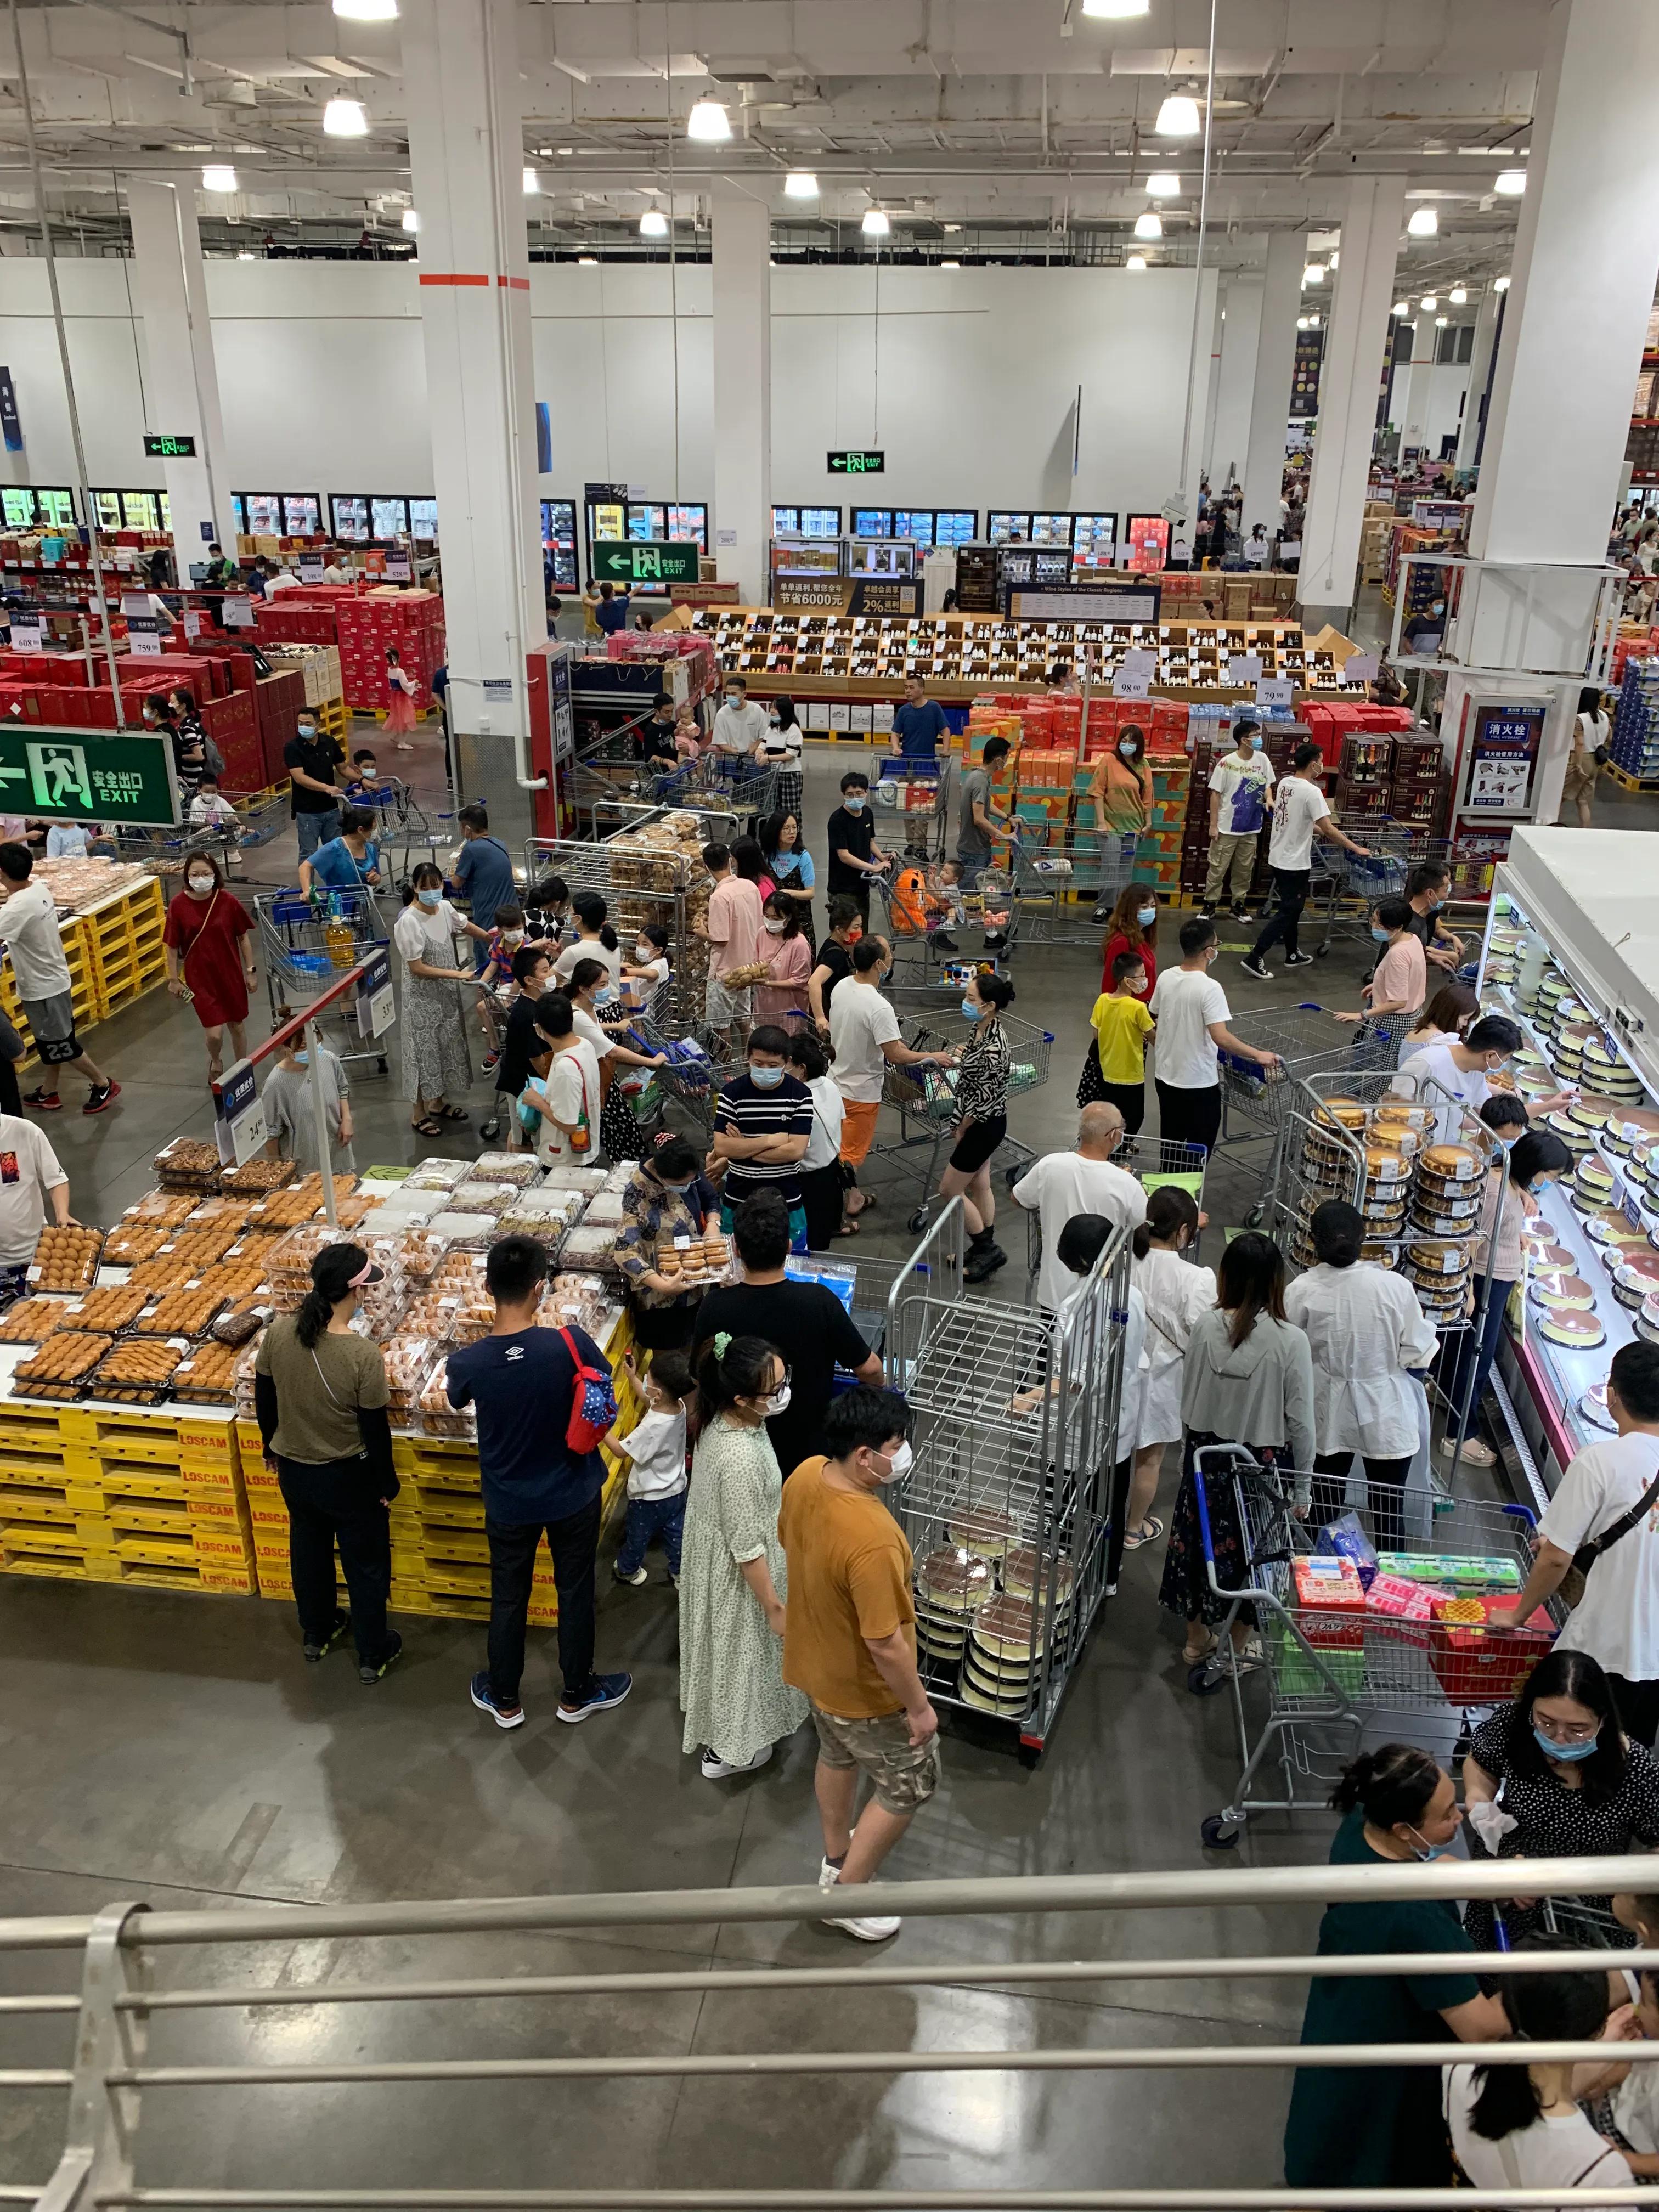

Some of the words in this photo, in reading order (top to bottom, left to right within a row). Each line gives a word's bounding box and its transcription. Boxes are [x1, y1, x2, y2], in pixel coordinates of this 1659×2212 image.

[662, 558, 686, 568] 安全出口
[780, 592, 843, 606] 节省6000元
[862, 599, 884, 612] 2%
[137, 644, 159, 653] 759.00
[1121, 684, 1141, 693] 98.00
[1264, 692, 1284, 701] 79.90
[1489, 724, 1526, 735] 消火栓
[92, 770, 143, 789] 安全出口
[100, 789, 139, 803] EXIT
[47, 1042, 74, 1060] 23
[235, 1076, 254, 1098] 优质优价
[179, 1435, 227, 1448] LOSCAM
[240, 1439, 262, 1449] LOS
[183, 1471, 229, 1485] LOSCAM
[189, 1503, 234, 1517] LOSCAM
[253, 1510, 289, 1523] LOSCA
[195, 1541, 242, 1555] LOSCAM
[202, 1573, 248, 1589] LOSCAM
